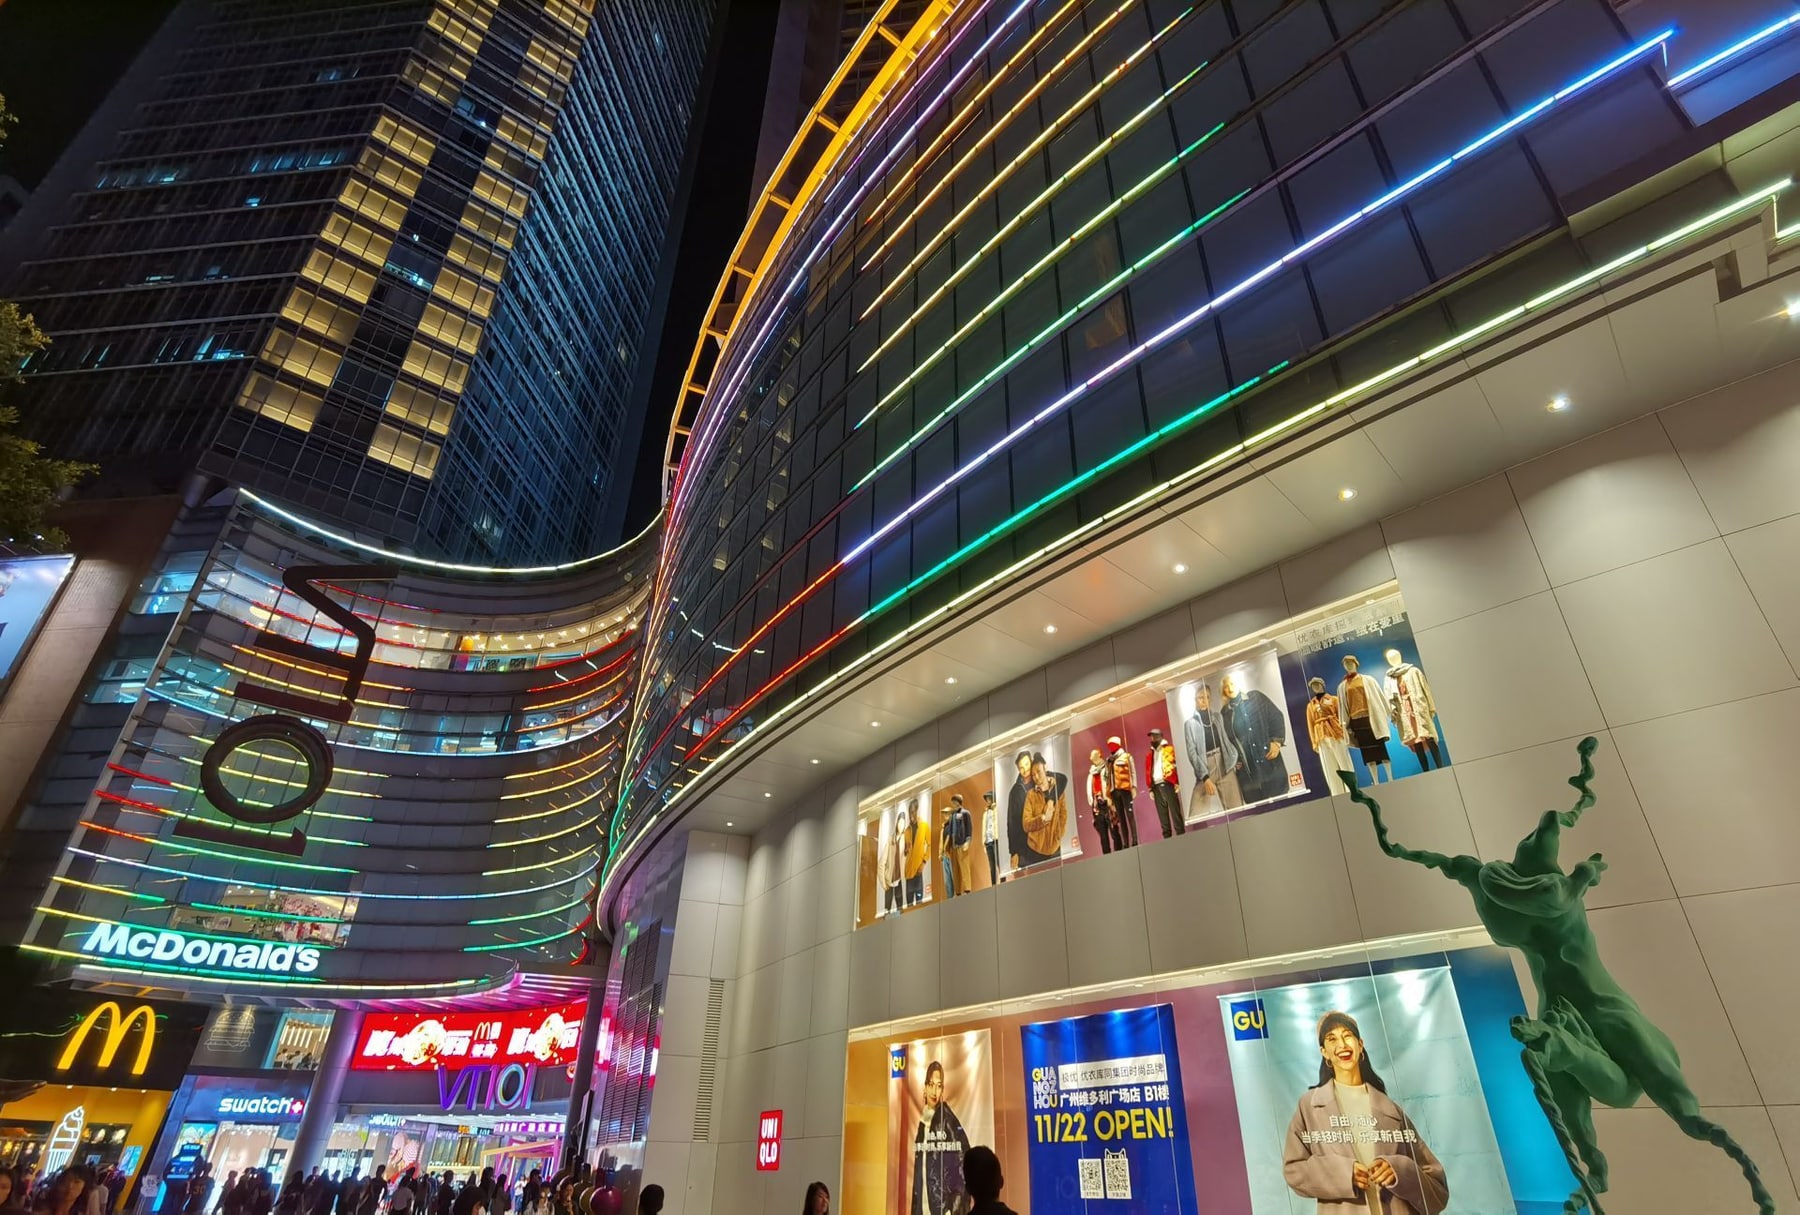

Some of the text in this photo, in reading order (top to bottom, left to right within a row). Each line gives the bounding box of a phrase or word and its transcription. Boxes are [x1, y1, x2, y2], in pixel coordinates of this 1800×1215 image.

[83, 922, 320, 972] McDonald's
[1234, 1010, 1265, 1031] GU
[892, 1056, 906, 1071] GU
[437, 1062, 537, 1110] VT101
[1060, 1086, 1141, 1108] 广州维多利广场店
[218, 1096, 292, 1114] swatch
[761, 1117, 778, 1139] UNI
[1034, 1106, 1175, 1143] 11/22 OPEN!
[760, 1141, 778, 1167] QLO
